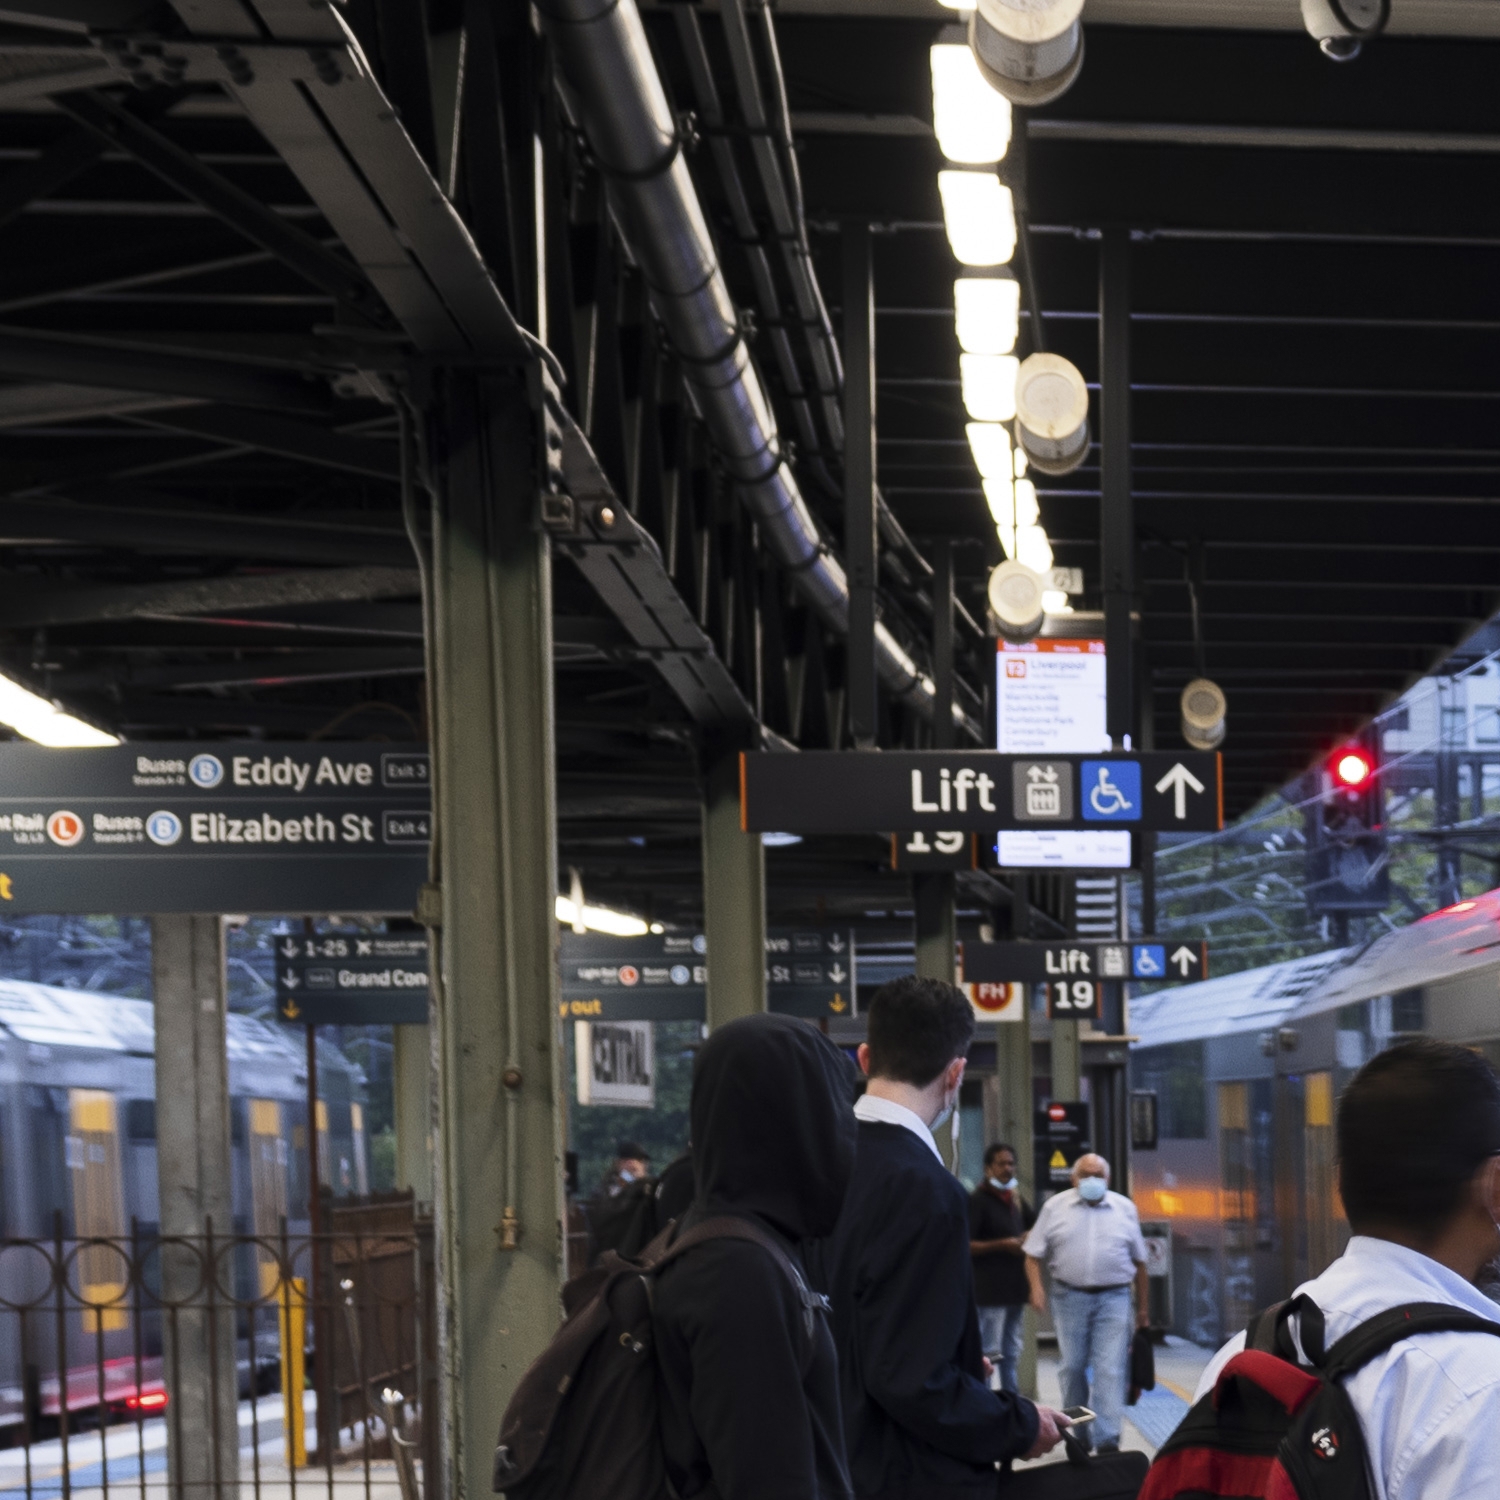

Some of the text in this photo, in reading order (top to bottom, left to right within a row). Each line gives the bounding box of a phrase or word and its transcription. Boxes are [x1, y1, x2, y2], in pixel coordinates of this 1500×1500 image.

[136, 756, 187, 774] Buses
[232, 756, 311, 792] Eddy
[315, 756, 374, 786] Ave
[387, 763, 415, 778] Exit
[416, 763, 427, 778] 3
[911, 768, 997, 813] Lift
[12, 812, 45, 832] Rail
[93, 813, 143, 831] Buses
[190, 812, 336, 842] Elizabeth
[341, 813, 374, 842] St
[388, 819, 415, 835] Exit
[417, 819, 428, 835] 4
[305, 938, 348, 958] 1-25
[772, 965, 790, 982] St
[1046, 949, 1091, 974] Lift
[338, 969, 391, 988] Grand
[978, 983, 1006, 1000] FH
[1054, 981, 1095, 1009] 19
